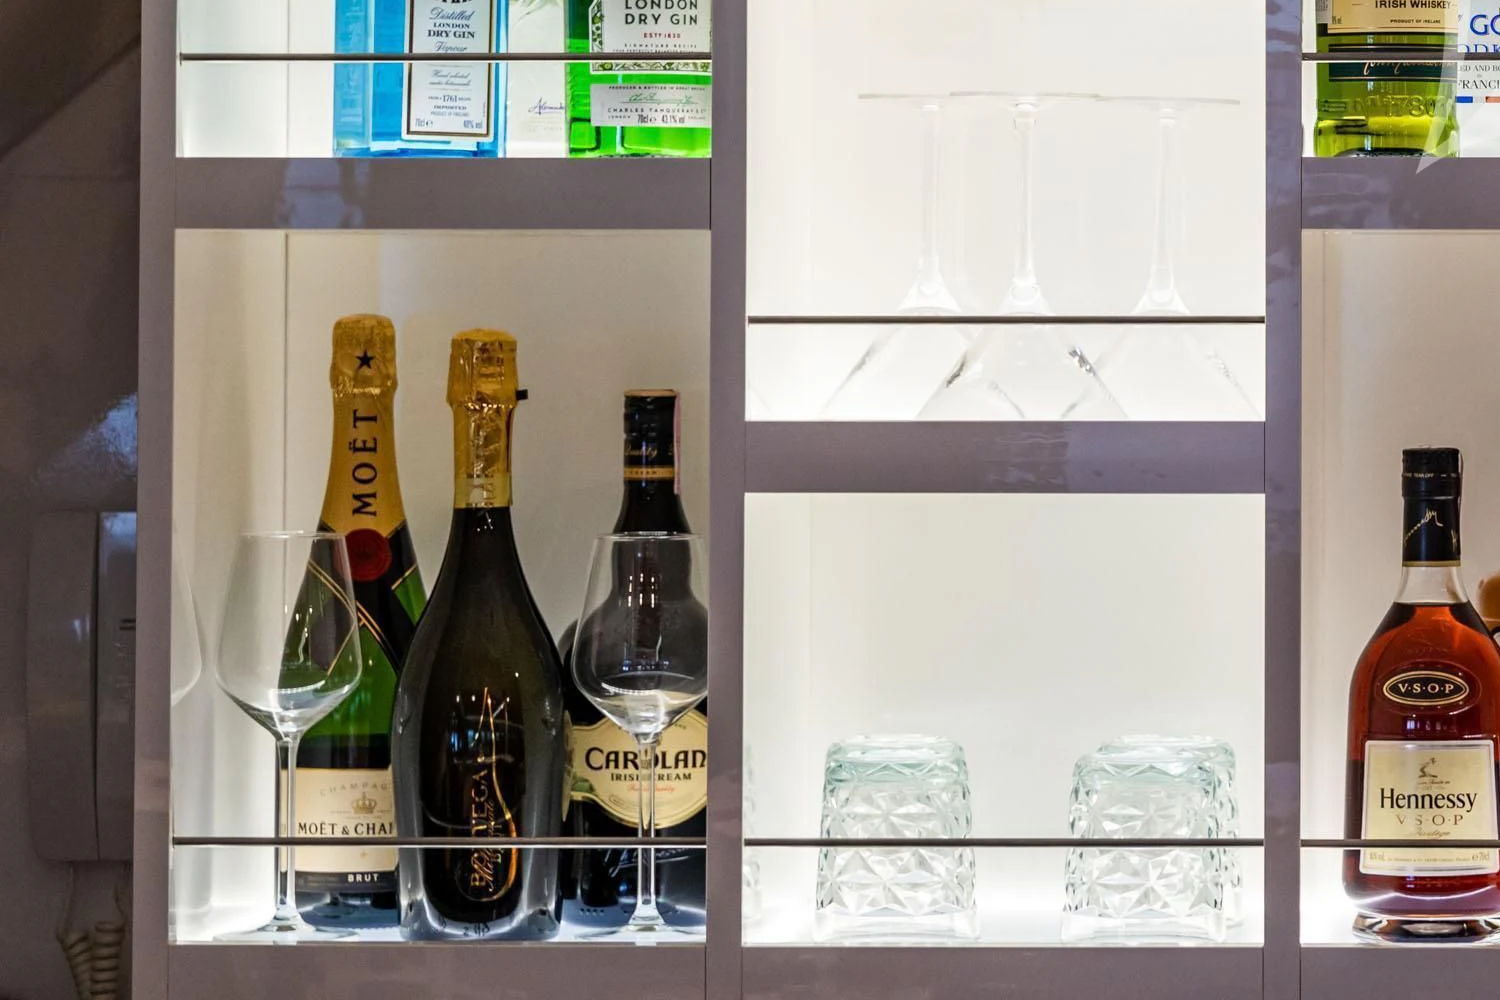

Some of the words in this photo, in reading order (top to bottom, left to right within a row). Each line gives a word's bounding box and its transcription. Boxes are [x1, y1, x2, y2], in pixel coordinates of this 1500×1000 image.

[1375, 0, 1407, 8] IRISH
[1410, 0, 1451, 9] WHISKEY
[429, 6, 476, 21] Distilled
[625, 14, 661, 25] DRY
[670, 14, 698, 25] GIN
[428, 30, 451, 38] DRY
[453, 31, 476, 39] GIN
[349, 408, 378, 517] MOËT
[585, 747, 707, 772] CAROLAN
[656, 773, 692, 781] REAM
[320, 782, 388, 797] CHAMPAG
[1380, 788, 1479, 812] Hennessy
[298, 821, 338, 835] MOËT
[341, 825, 350, 835] &
[347, 873, 379, 883] BRUT
